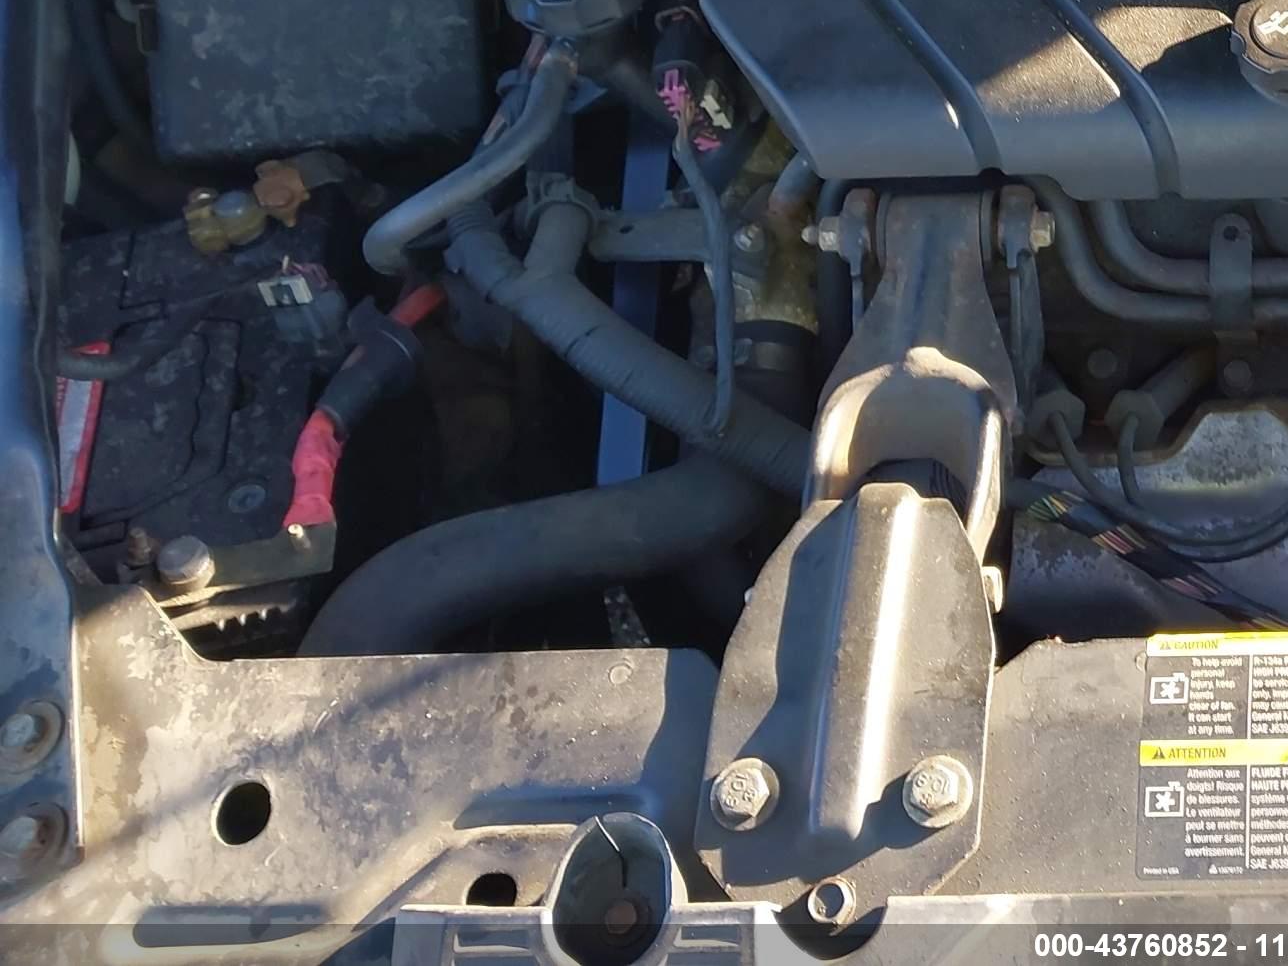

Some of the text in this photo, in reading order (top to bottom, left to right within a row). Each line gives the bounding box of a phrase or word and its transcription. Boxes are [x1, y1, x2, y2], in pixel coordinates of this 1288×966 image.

[1174, 639, 1218, 650] CAUTION
[1211, 701, 1219, 711] of
[1196, 714, 1211, 722] can
[1212, 713, 1232, 722] start
[1252, 711, 1282, 721] General
[1188, 725, 1197, 734] at
[1198, 726, 1213, 736] any
[1169, 748, 1226, 759] ATTENTION
[1187, 768, 1240, 778] Attention aux
[1216, 781, 1244, 792] Risque
[1251, 780, 1279, 790] HAUTE
[1186, 794, 1197, 805] de
[1186, 807, 1241, 817] Le ventilateur
[1185, 821, 1204, 832] peut
[1206, 822, 1216, 830] se
[1224, 835, 1244, 843] sans
[1251, 845, 1281, 856] General
[1250, 858, 1267, 869] SAE
